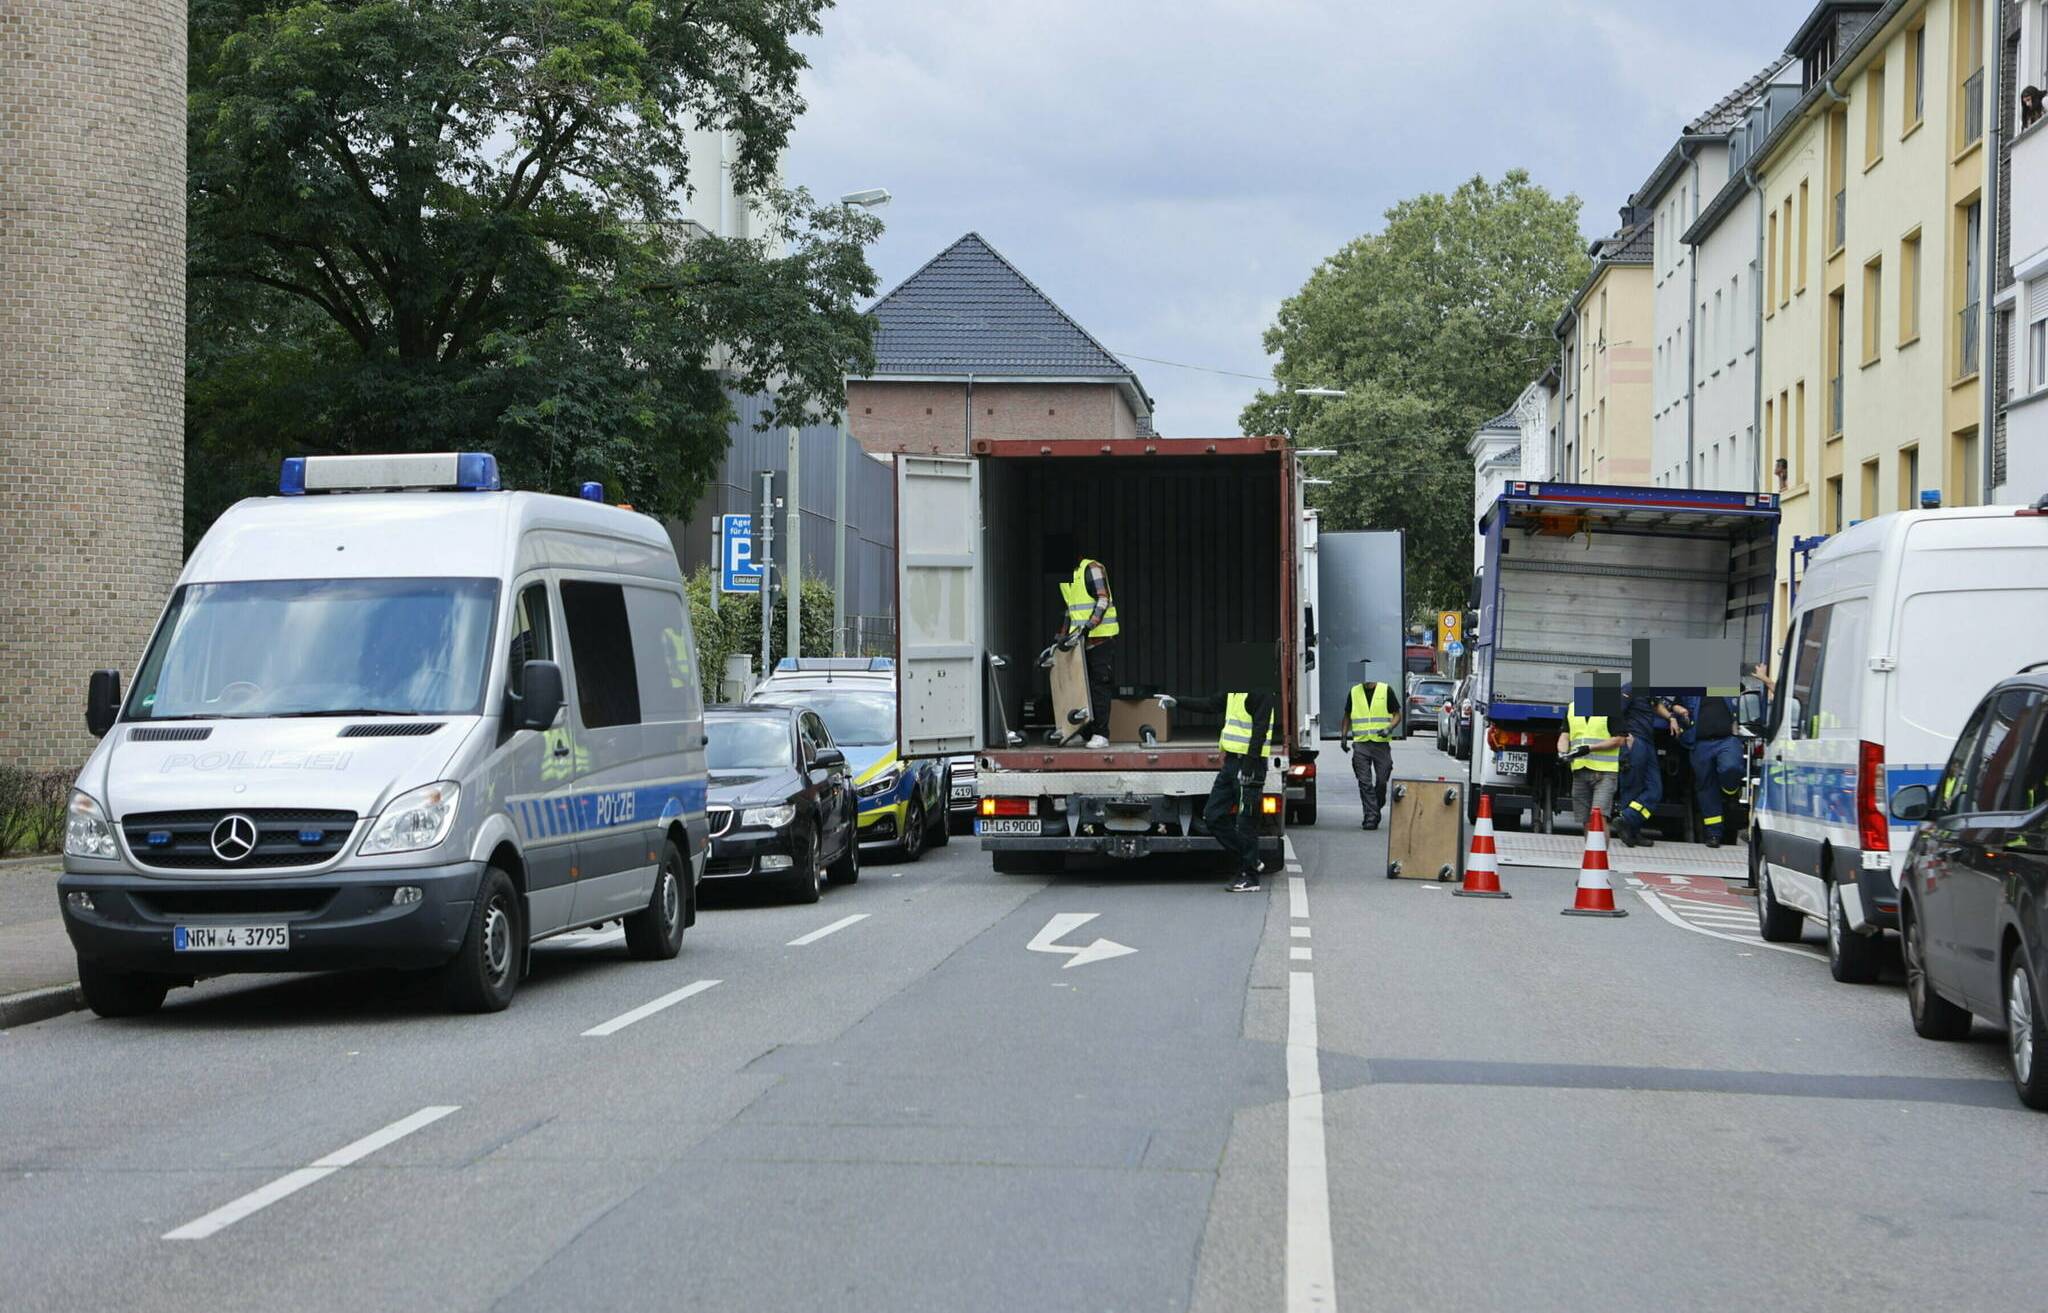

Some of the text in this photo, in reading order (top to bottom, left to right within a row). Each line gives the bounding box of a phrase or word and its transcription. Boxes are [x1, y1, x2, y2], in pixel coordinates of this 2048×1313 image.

[730, 527, 742, 535] für
[731, 537, 751, 572] P
[159, 750, 354, 774] POLIZEI
[1499, 761, 1525, 772] 93758
[596, 791, 635, 825] POLIZEI
[982, 820, 1040, 832] D LG 9000
[186, 929, 216, 947] NRW
